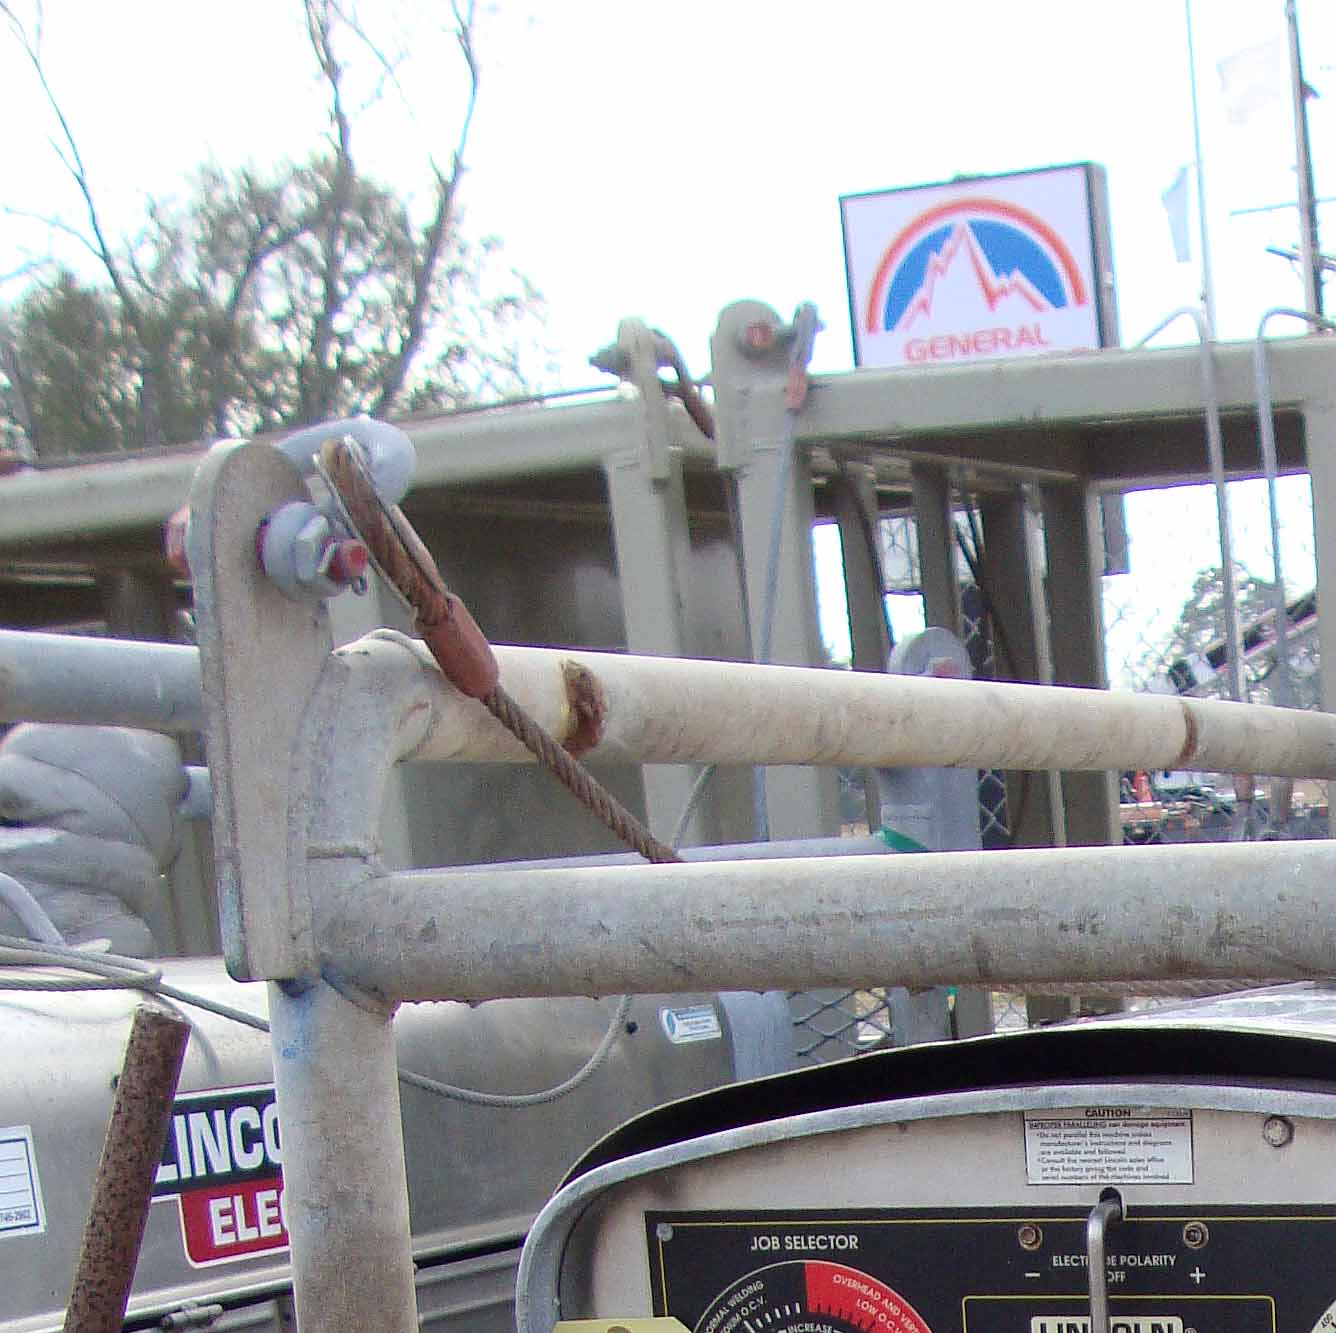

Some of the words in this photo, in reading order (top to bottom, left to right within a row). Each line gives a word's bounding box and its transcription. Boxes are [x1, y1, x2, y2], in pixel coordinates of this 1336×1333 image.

[905, 322, 1050, 362] GENERAL
[1085, 1109, 1131, 1117] CAUTION
[750, 1235, 781, 1250] JOB
[784, 1235, 859, 1250] SELECTOR
[1119, 1255, 1177, 1267] POLARITY
[727, 1280, 764, 1307] WELDING
[832, 1273, 881, 1301] OVERHEAD
[881, 1298, 900, 1317] AND
[856, 1298, 879, 1317] LOW
